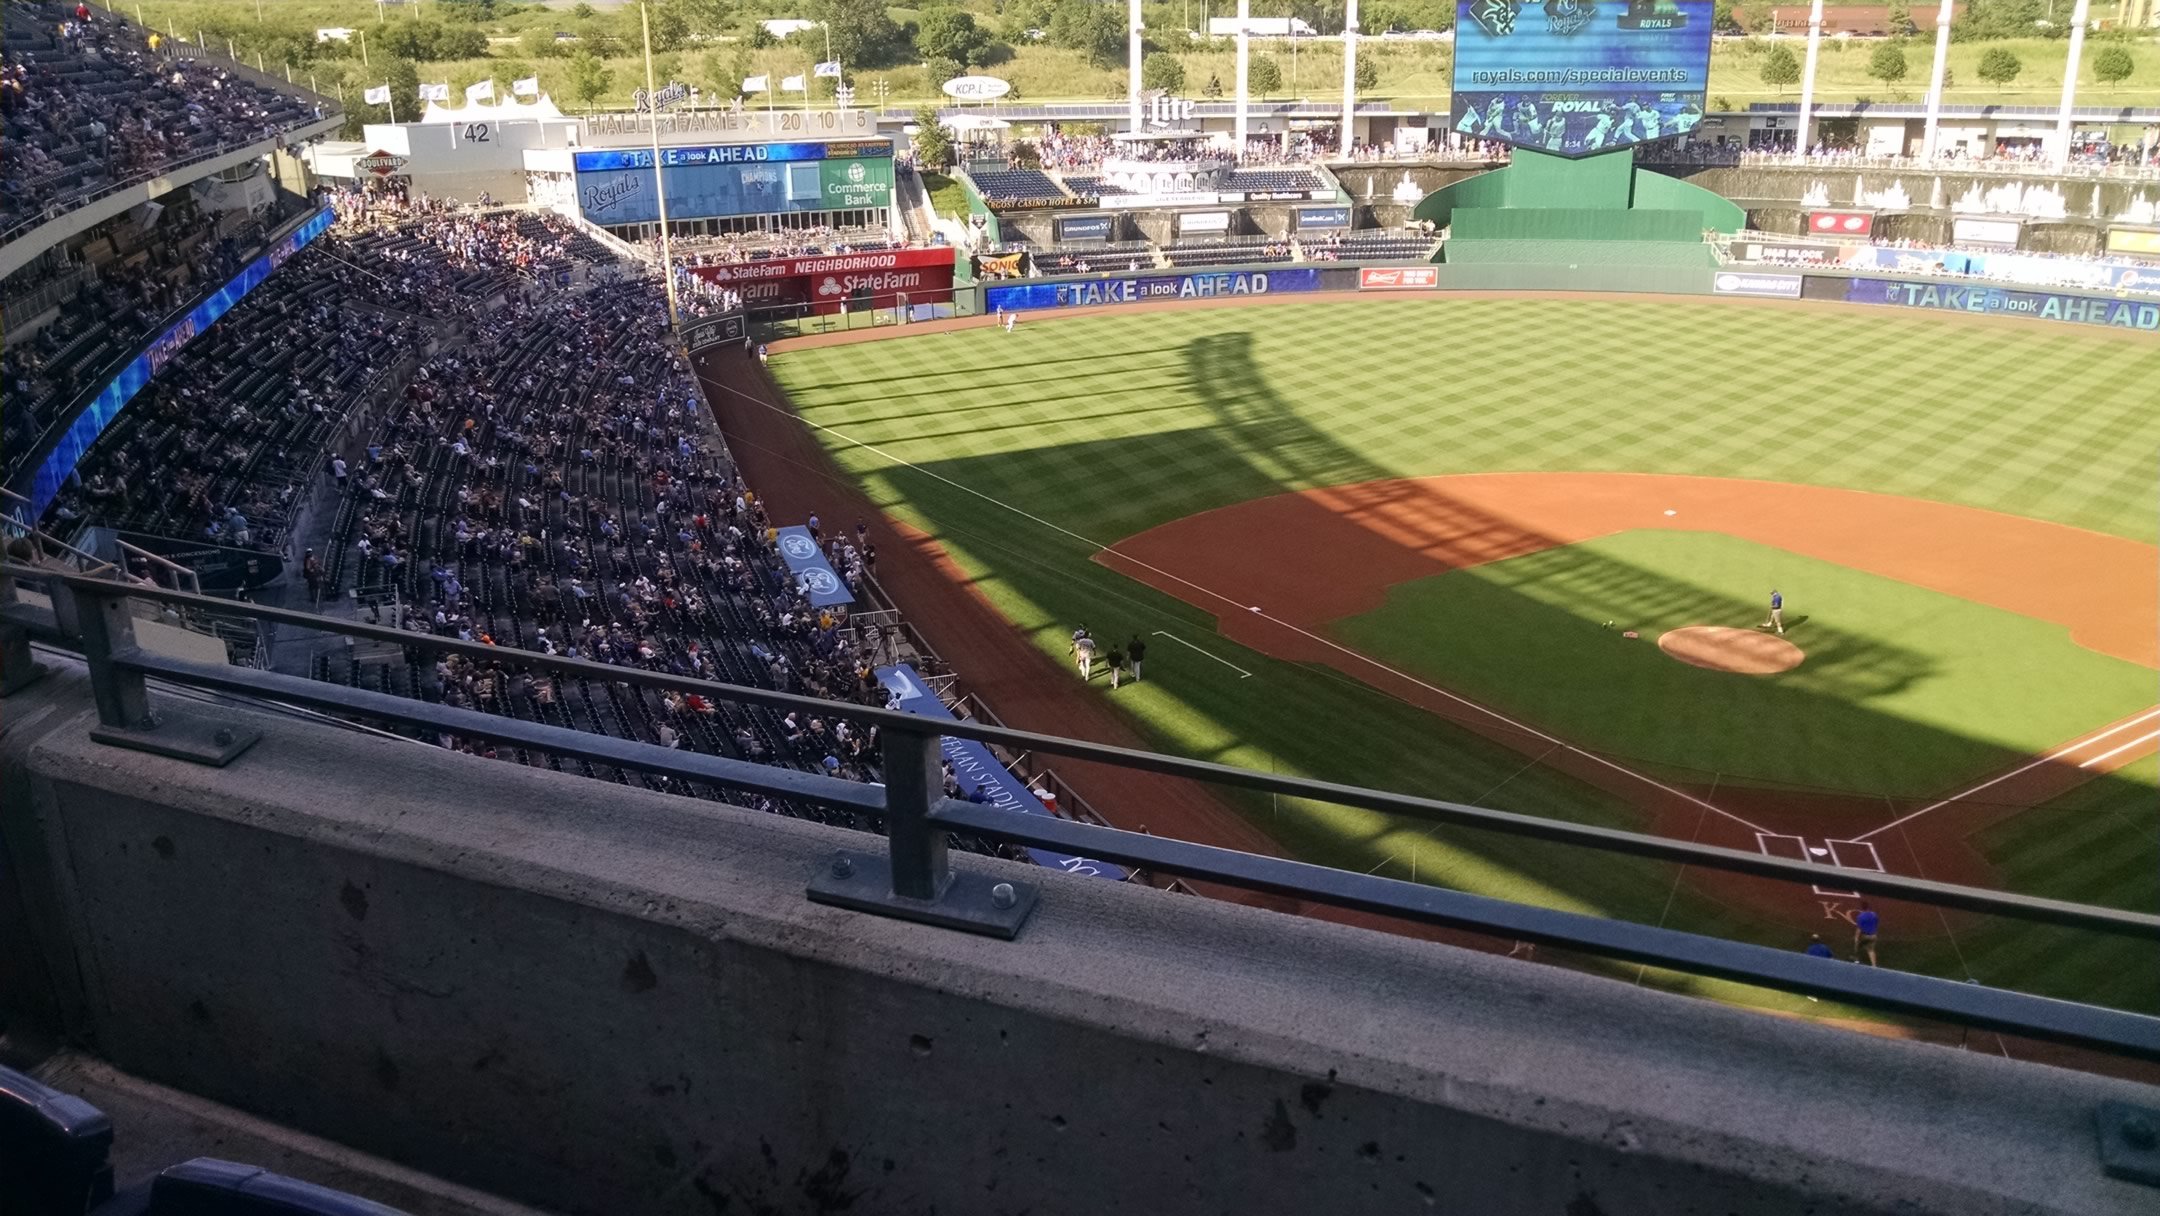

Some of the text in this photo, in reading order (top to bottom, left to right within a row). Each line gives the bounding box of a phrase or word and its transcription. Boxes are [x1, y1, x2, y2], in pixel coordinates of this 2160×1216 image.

[1640, 19, 1672, 29] ROYALS
[1472, 67, 1688, 86] royals.com/specialevents
[1540, 93, 1580, 101] FOREVER
[1149, 96, 1195, 127] Lite
[1552, 101, 1601, 112] ROYAL
[585, 113, 649, 136] HALL
[675, 111, 739, 133] FAME
[781, 113, 801, 131] 20
[818, 111, 834, 129] 10
[856, 111, 866, 127] 5
[464, 123, 490, 143] 42
[362, 156, 402, 168] BOULEVARD
[632, 148, 679, 167] TAKE
[687, 150, 707, 161] look
[708, 146, 768, 163] AHEAD
[584, 174, 640, 212] Royals
[828, 182, 887, 194] Commerce
[845, 194, 873, 206] Bank
[1017, 199, 1047, 208] CASINO
[1049, 198, 1074, 207] HOTEL
[1083, 197, 1098, 205] SPA
[1064, 224, 1100, 232] GRUNDFOS
[794, 255, 897, 274] NEIGHBORHOOD
[981, 259, 1019, 273] SONIC
[1071, 273, 1268, 305] TAKE a look AHEAD
[1777, 278, 1799, 291] CITY
[1904, 283, 2159, 330] TAKE a look AHEAD
[941, 734, 985, 773] FFMAN
